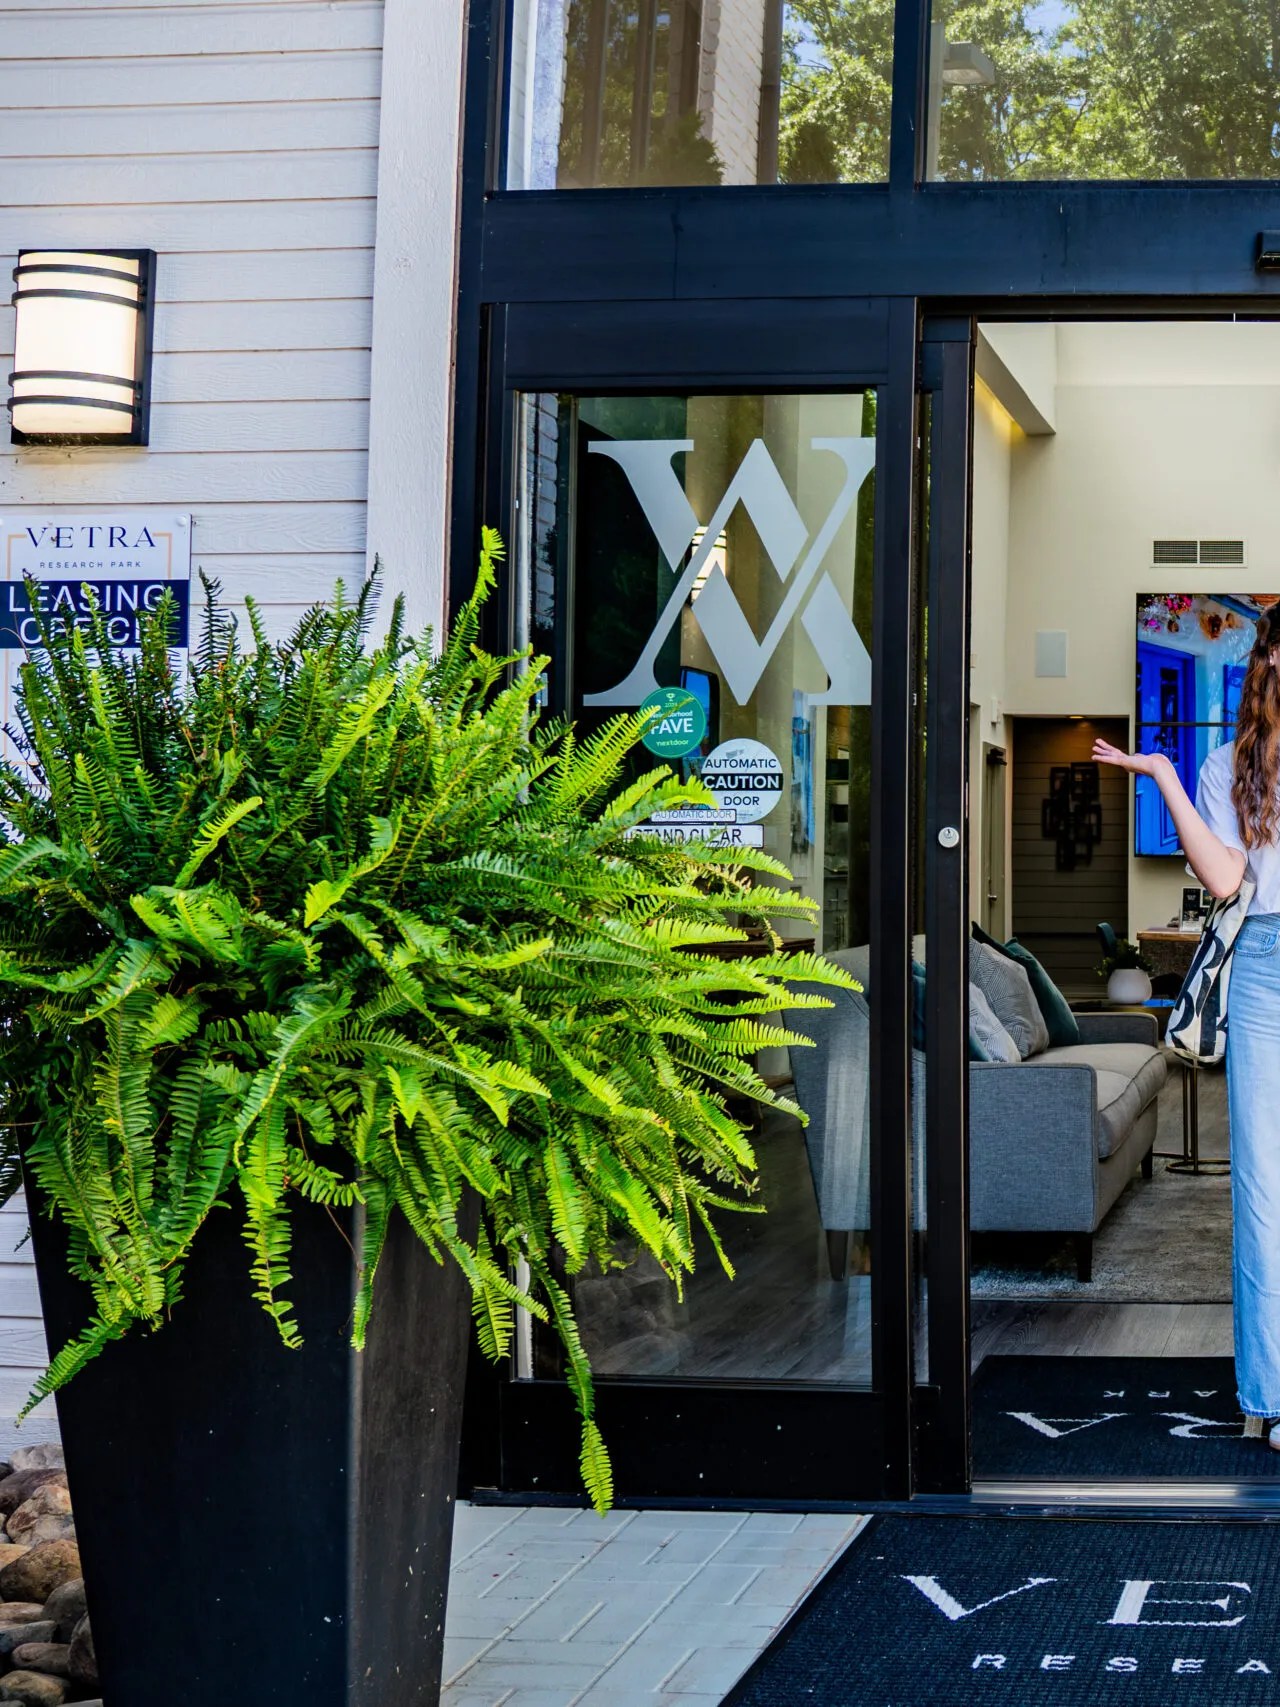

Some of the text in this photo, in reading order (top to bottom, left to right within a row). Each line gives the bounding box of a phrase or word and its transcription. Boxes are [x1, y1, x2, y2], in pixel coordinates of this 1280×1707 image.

[26, 526, 157, 549] VETRA
[40, 561, 104, 569] RESEARCH
[705, 758, 777, 769] AUTOMATIC
[703, 775, 780, 790] CAUTION
[723, 796, 760, 806] DOOR
[706, 809, 732, 819] DOOR
